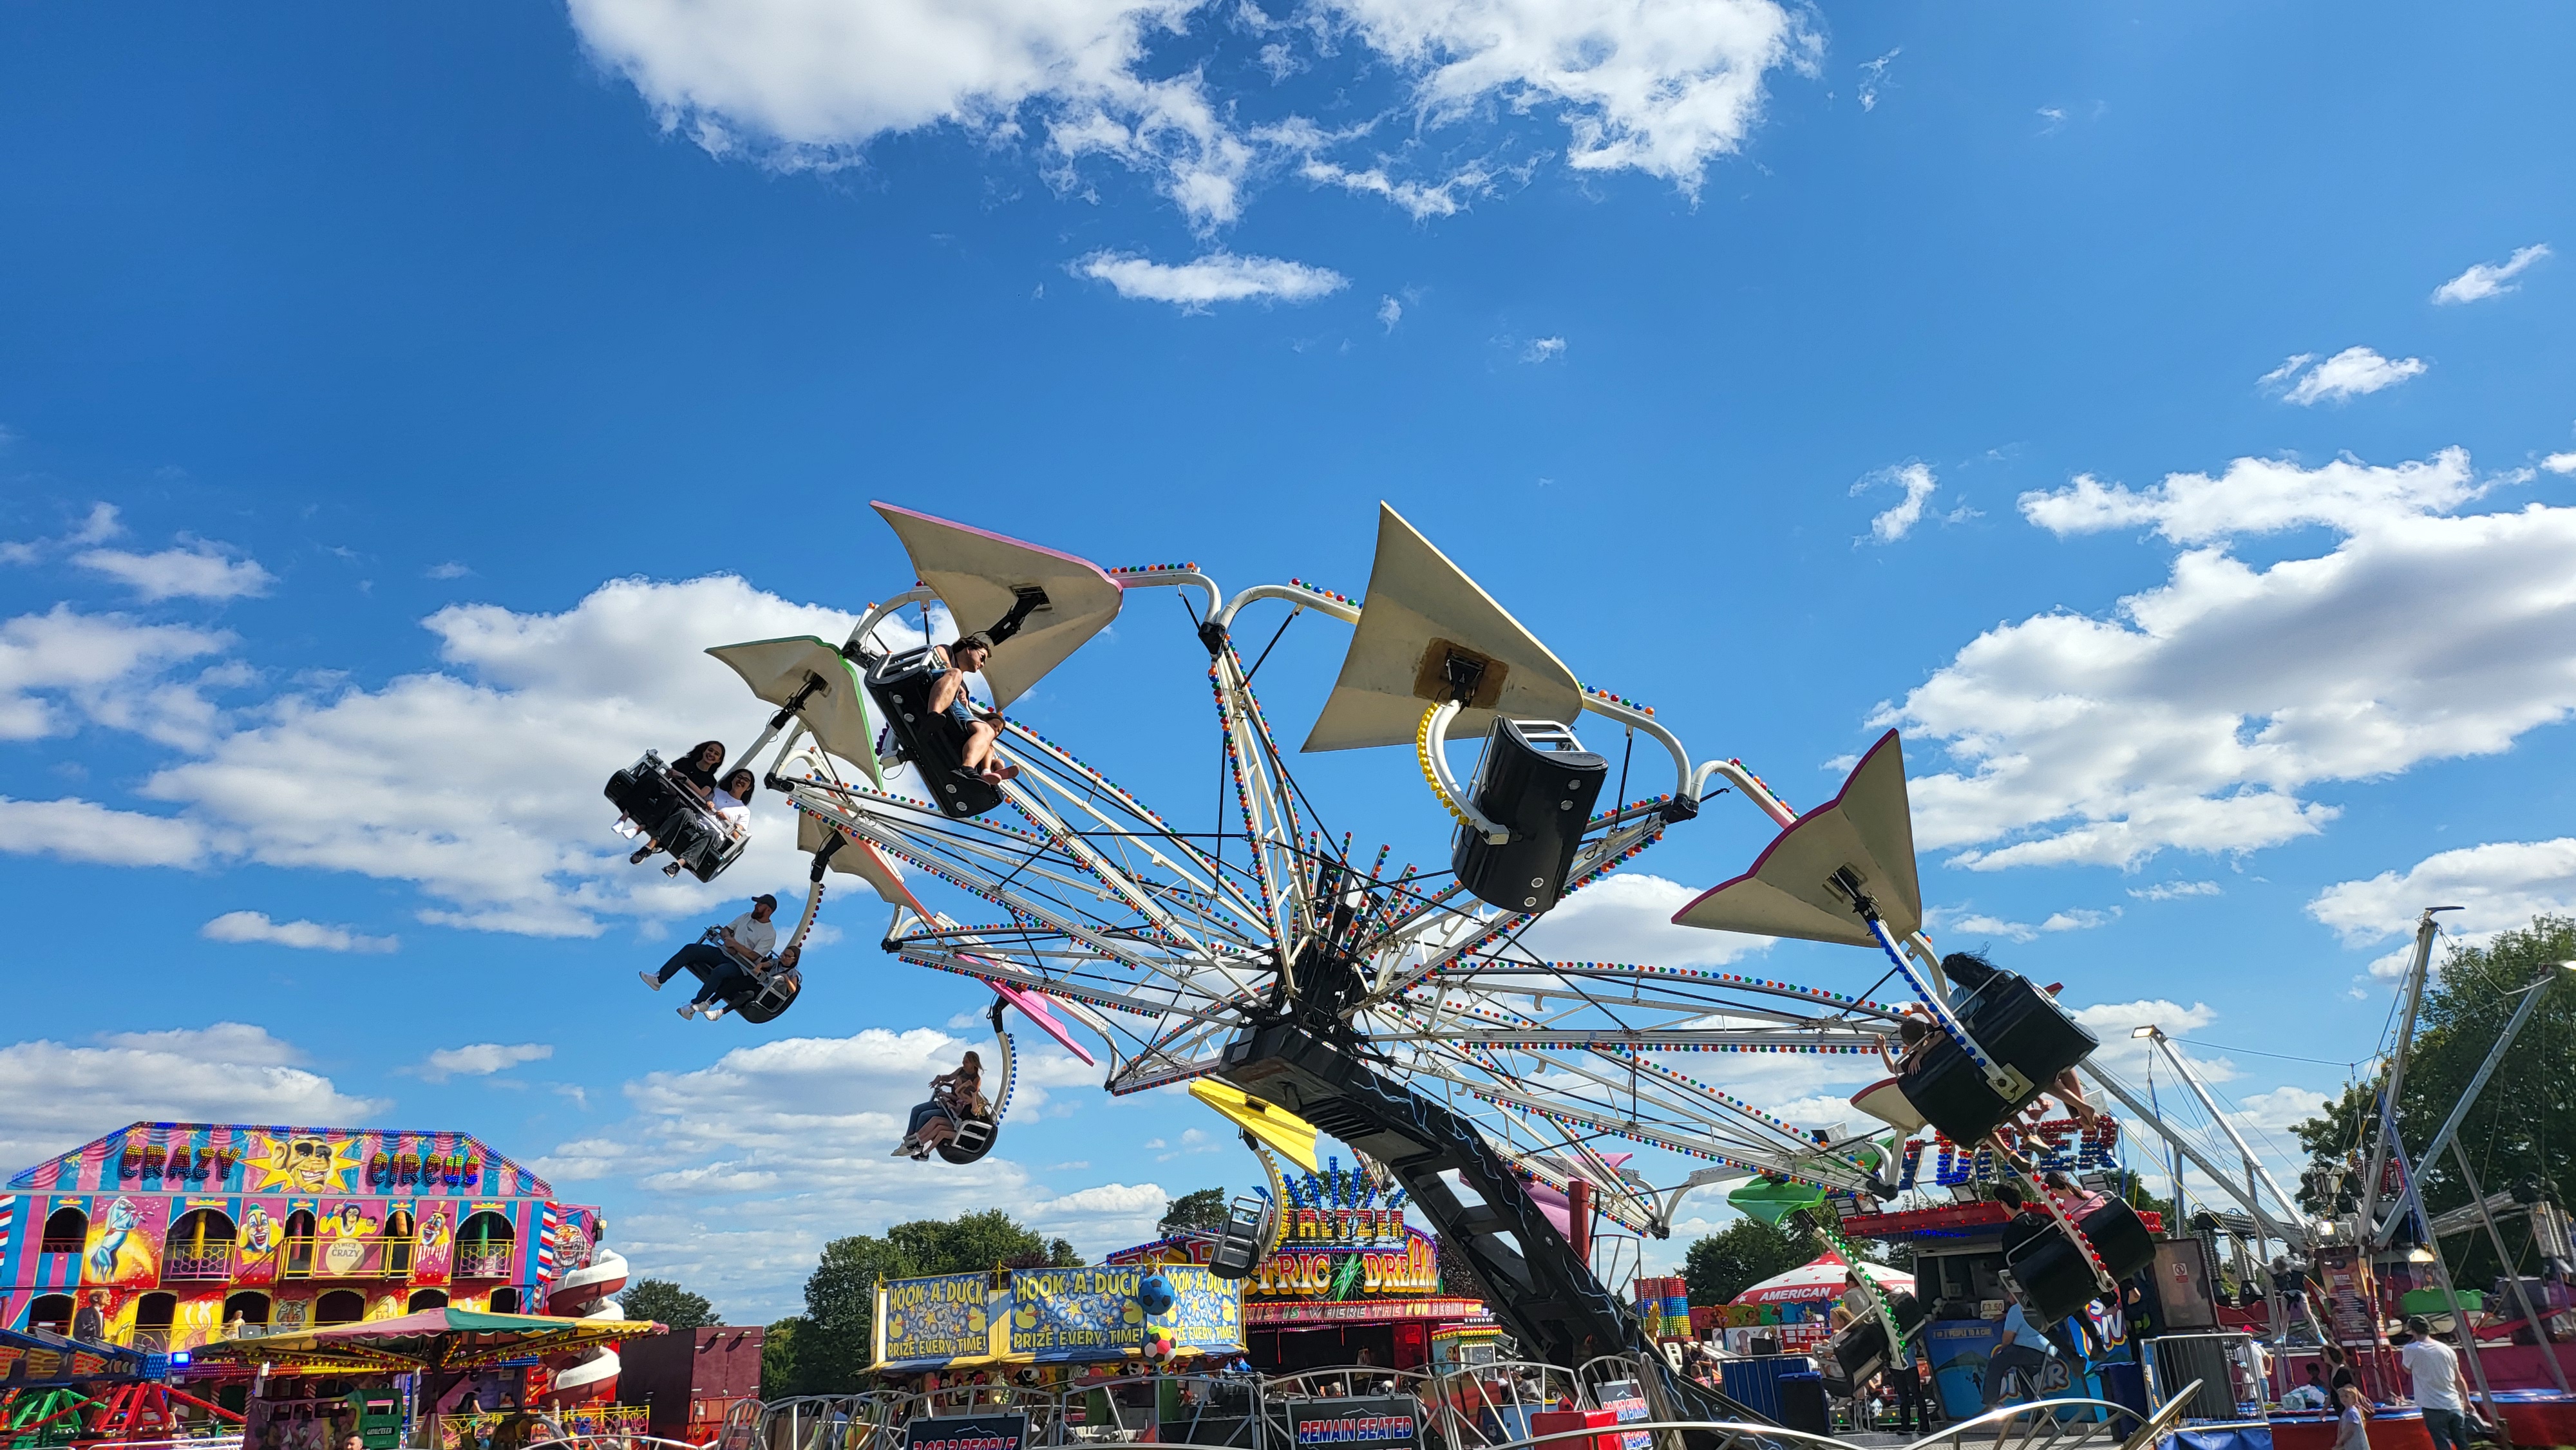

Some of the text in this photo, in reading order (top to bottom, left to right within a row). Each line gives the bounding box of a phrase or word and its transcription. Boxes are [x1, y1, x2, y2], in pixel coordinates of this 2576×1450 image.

[123, 1144, 480, 1186] CRAZY CIRCUS
[332, 1249, 360, 1257] CRAZY
[890, 1280, 984, 1312] HOOK A DUCK
[1016, 1272, 1141, 1303] HOOK A DUCK
[1196, 1272, 1203, 1291] A
[1207, 1273, 1233, 1298] DUCK
[1759, 1287, 1830, 1301] AMERICAN
[1245, 1302, 1464, 1320] HIS IS WHERE THE FUN BEGINS
[1014, 1328, 1144, 1348] PRIZE EVERY TIME!
[1188, 1326, 1212, 1341] EVERY
[1215, 1325, 1236, 1339] TIME!
[887, 1335, 986, 1357] PRIZE EVERY TIME!
[1299, 1416, 1413, 1444] REMAIN SEATED
